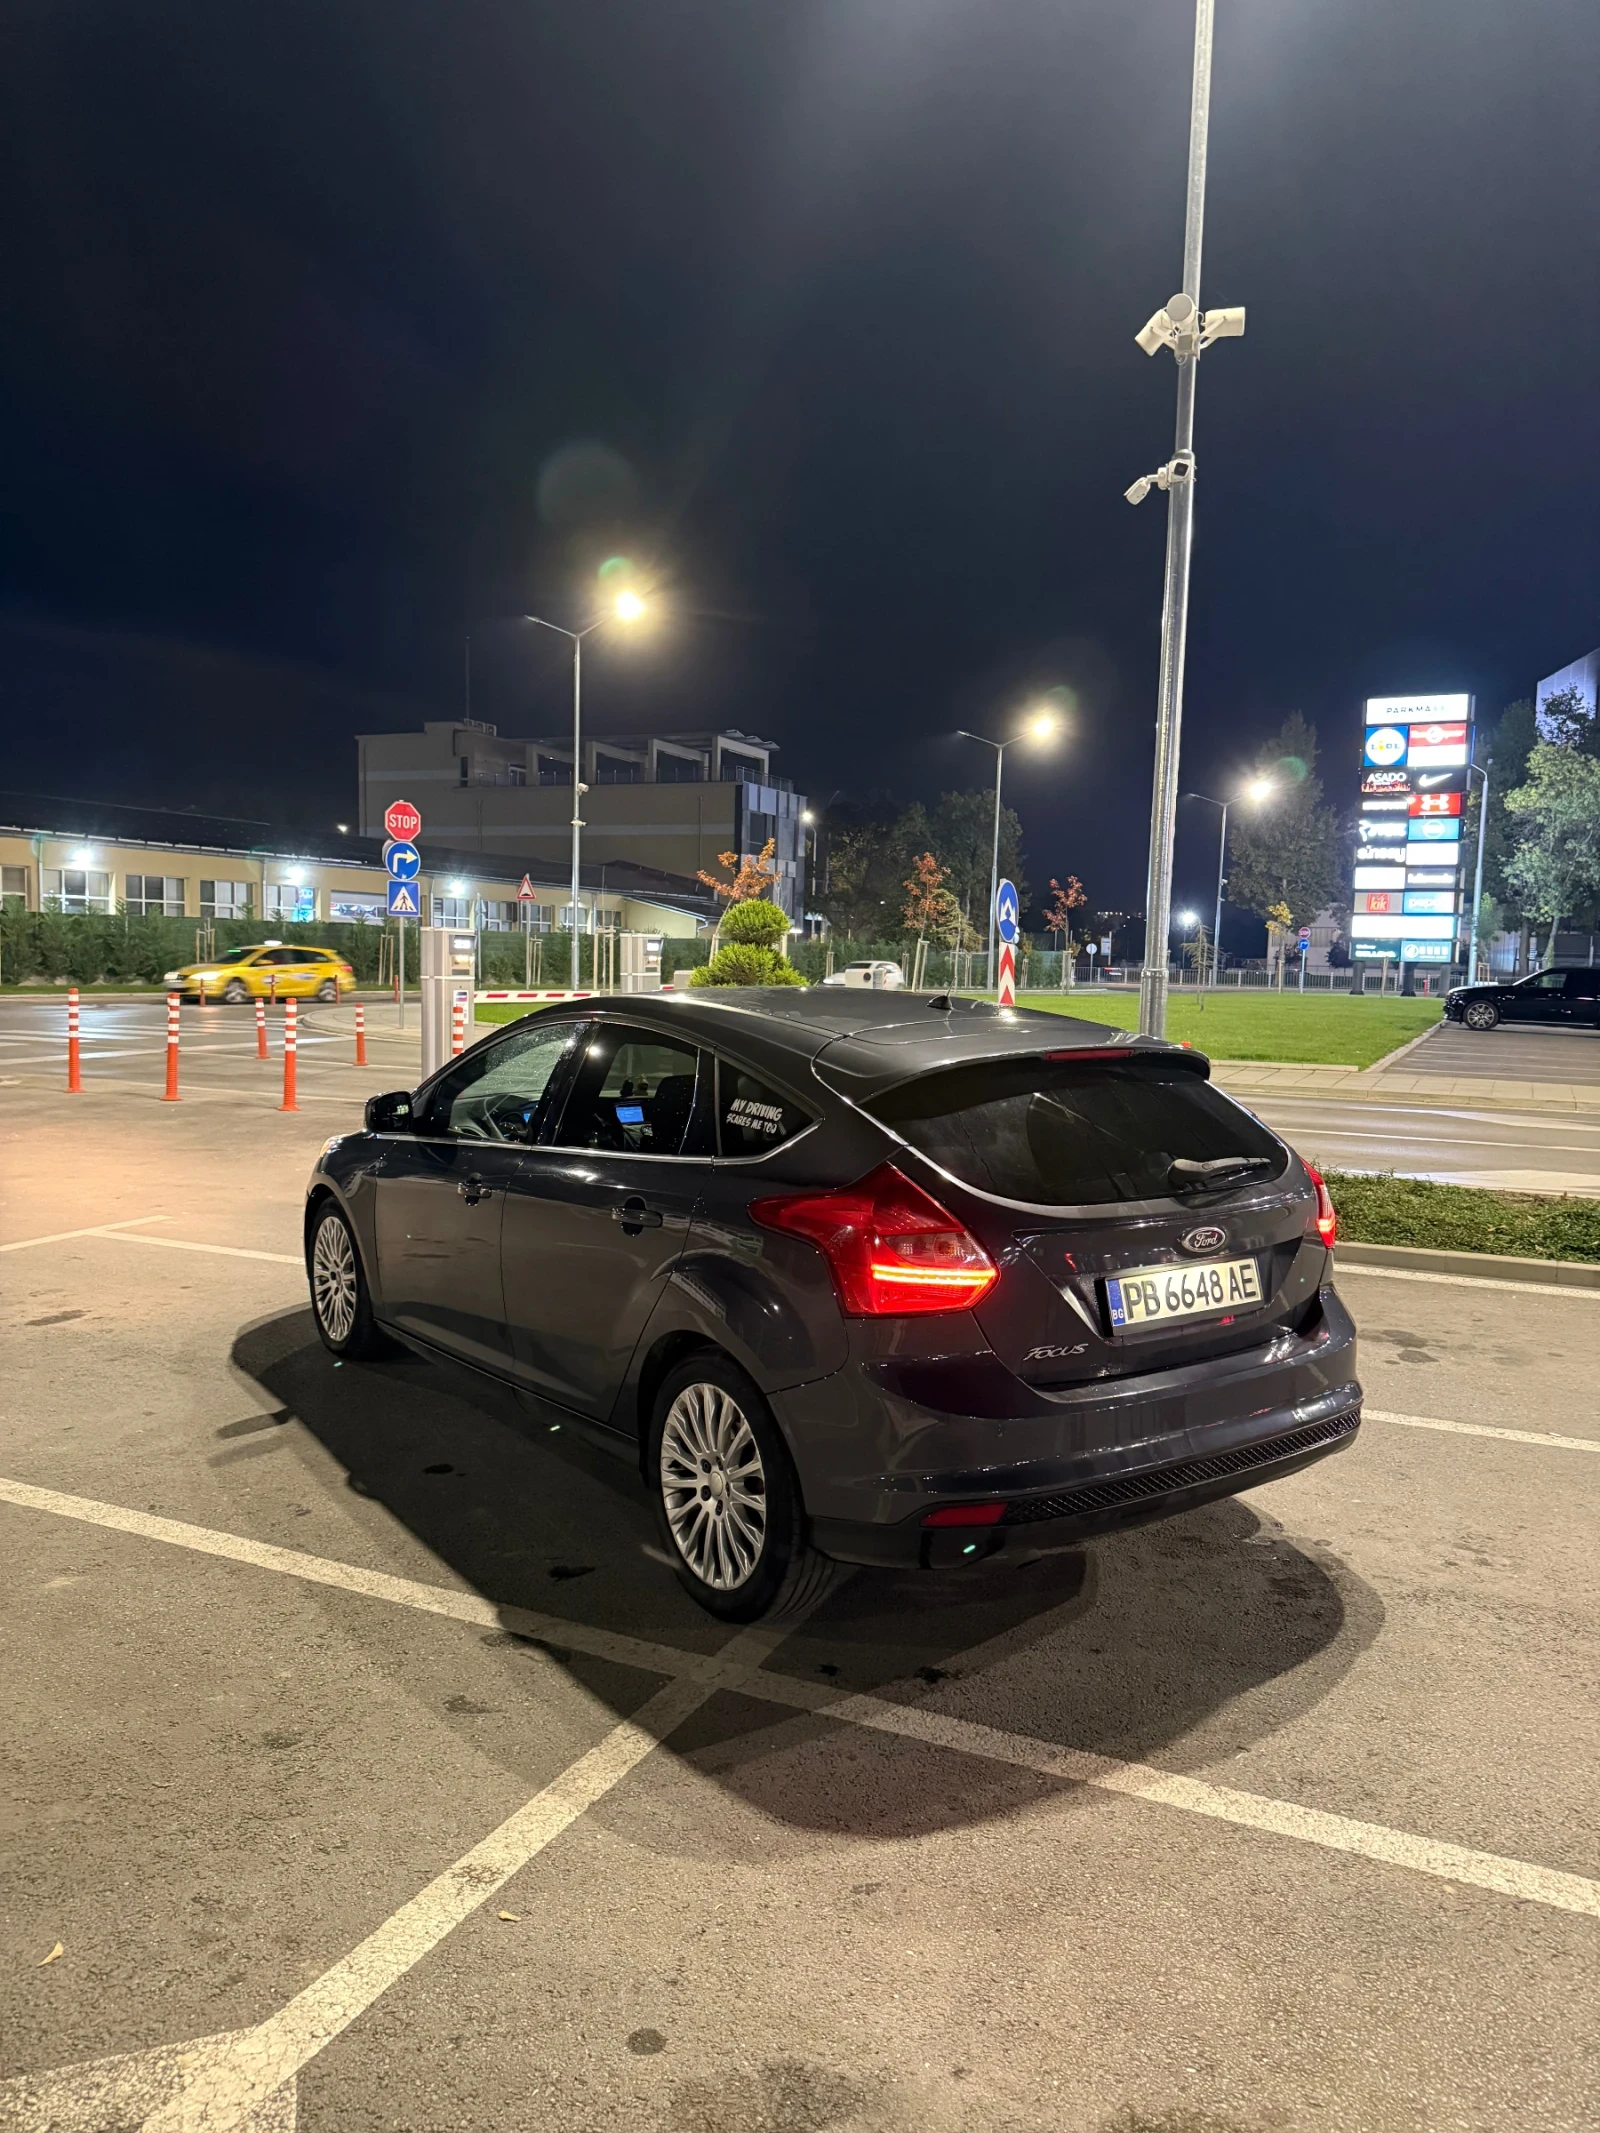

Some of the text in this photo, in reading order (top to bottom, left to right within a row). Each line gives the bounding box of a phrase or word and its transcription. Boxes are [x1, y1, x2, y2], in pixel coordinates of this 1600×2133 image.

[1386, 705, 1445, 713] PARKMA
[1366, 771, 1407, 783] ASADO
[389, 814, 418, 829] STOP
[730, 1098, 783, 1121] MY DRIVING
[726, 1113, 778, 1134] SCARES ME TOO
[1194, 1232, 1218, 1248] Ford
[1122, 1264, 1257, 1320] PB 6648 AE
[1112, 1309, 1124, 1320] BG
